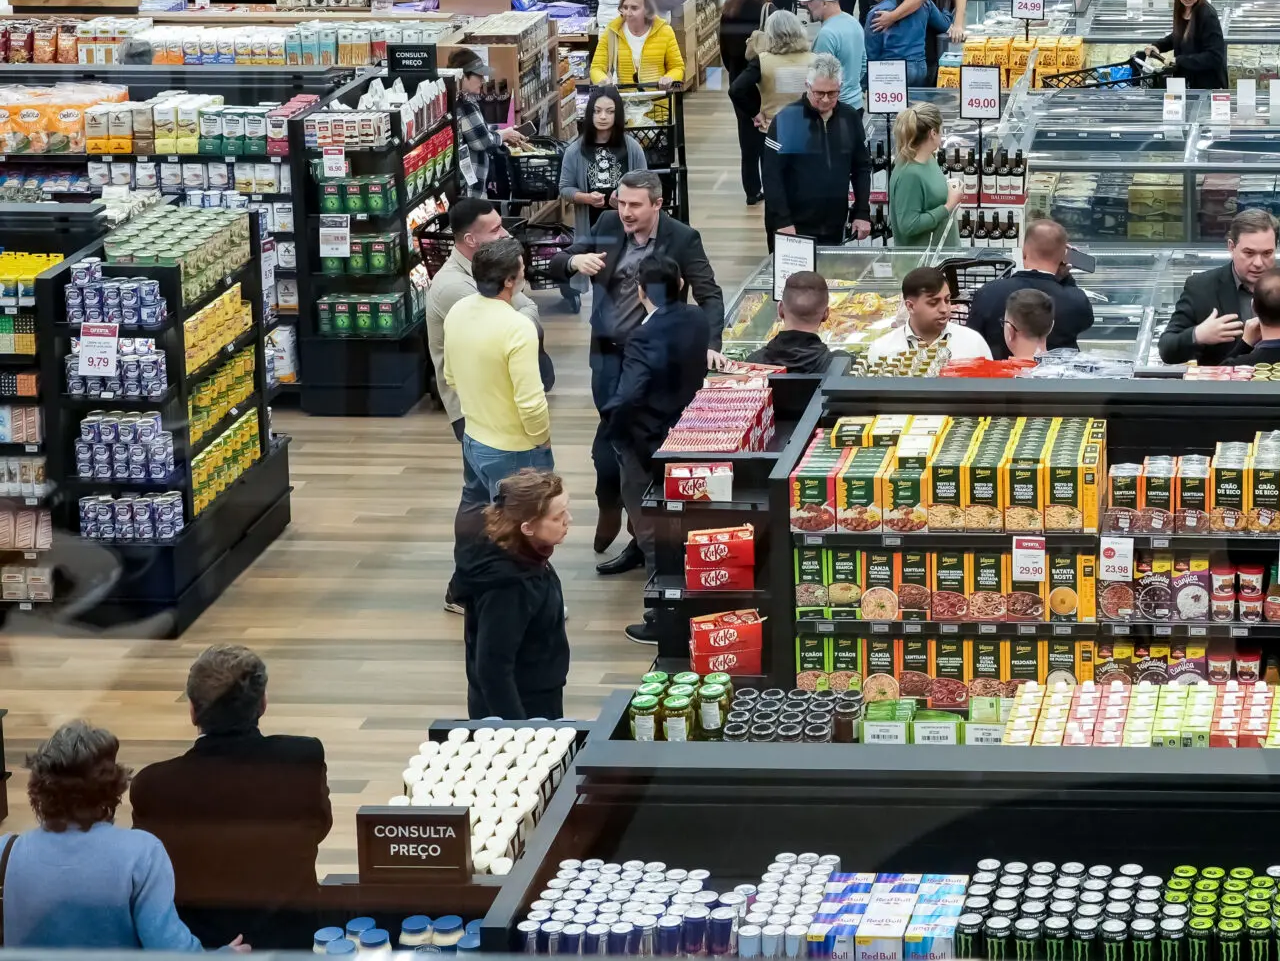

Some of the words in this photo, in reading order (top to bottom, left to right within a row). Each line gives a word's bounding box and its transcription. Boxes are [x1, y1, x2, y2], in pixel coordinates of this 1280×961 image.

[1018, 2, 1041, 12] 24,99
[874, 92, 903, 103] 39,90
[967, 98, 996, 109] 49,00
[87, 356, 109, 368] 9,79
[682, 479, 707, 494] KitKat
[703, 543, 728, 561] KitKat
[1019, 566, 1043, 575] 29,90
[1105, 565, 1129, 574] 23,98
[702, 570, 729, 587] KitKat
[1173, 574, 1199, 587] Canjica
[711, 628, 738, 646] KitKat
[710, 653, 737, 670] KitKat
[374, 825, 456, 838] CONSULTA
[390, 843, 441, 859] PREÇO
[831, 952, 848, 960] Bull
[861, 952, 879, 960] Red
[880, 952, 897, 960] Bull
